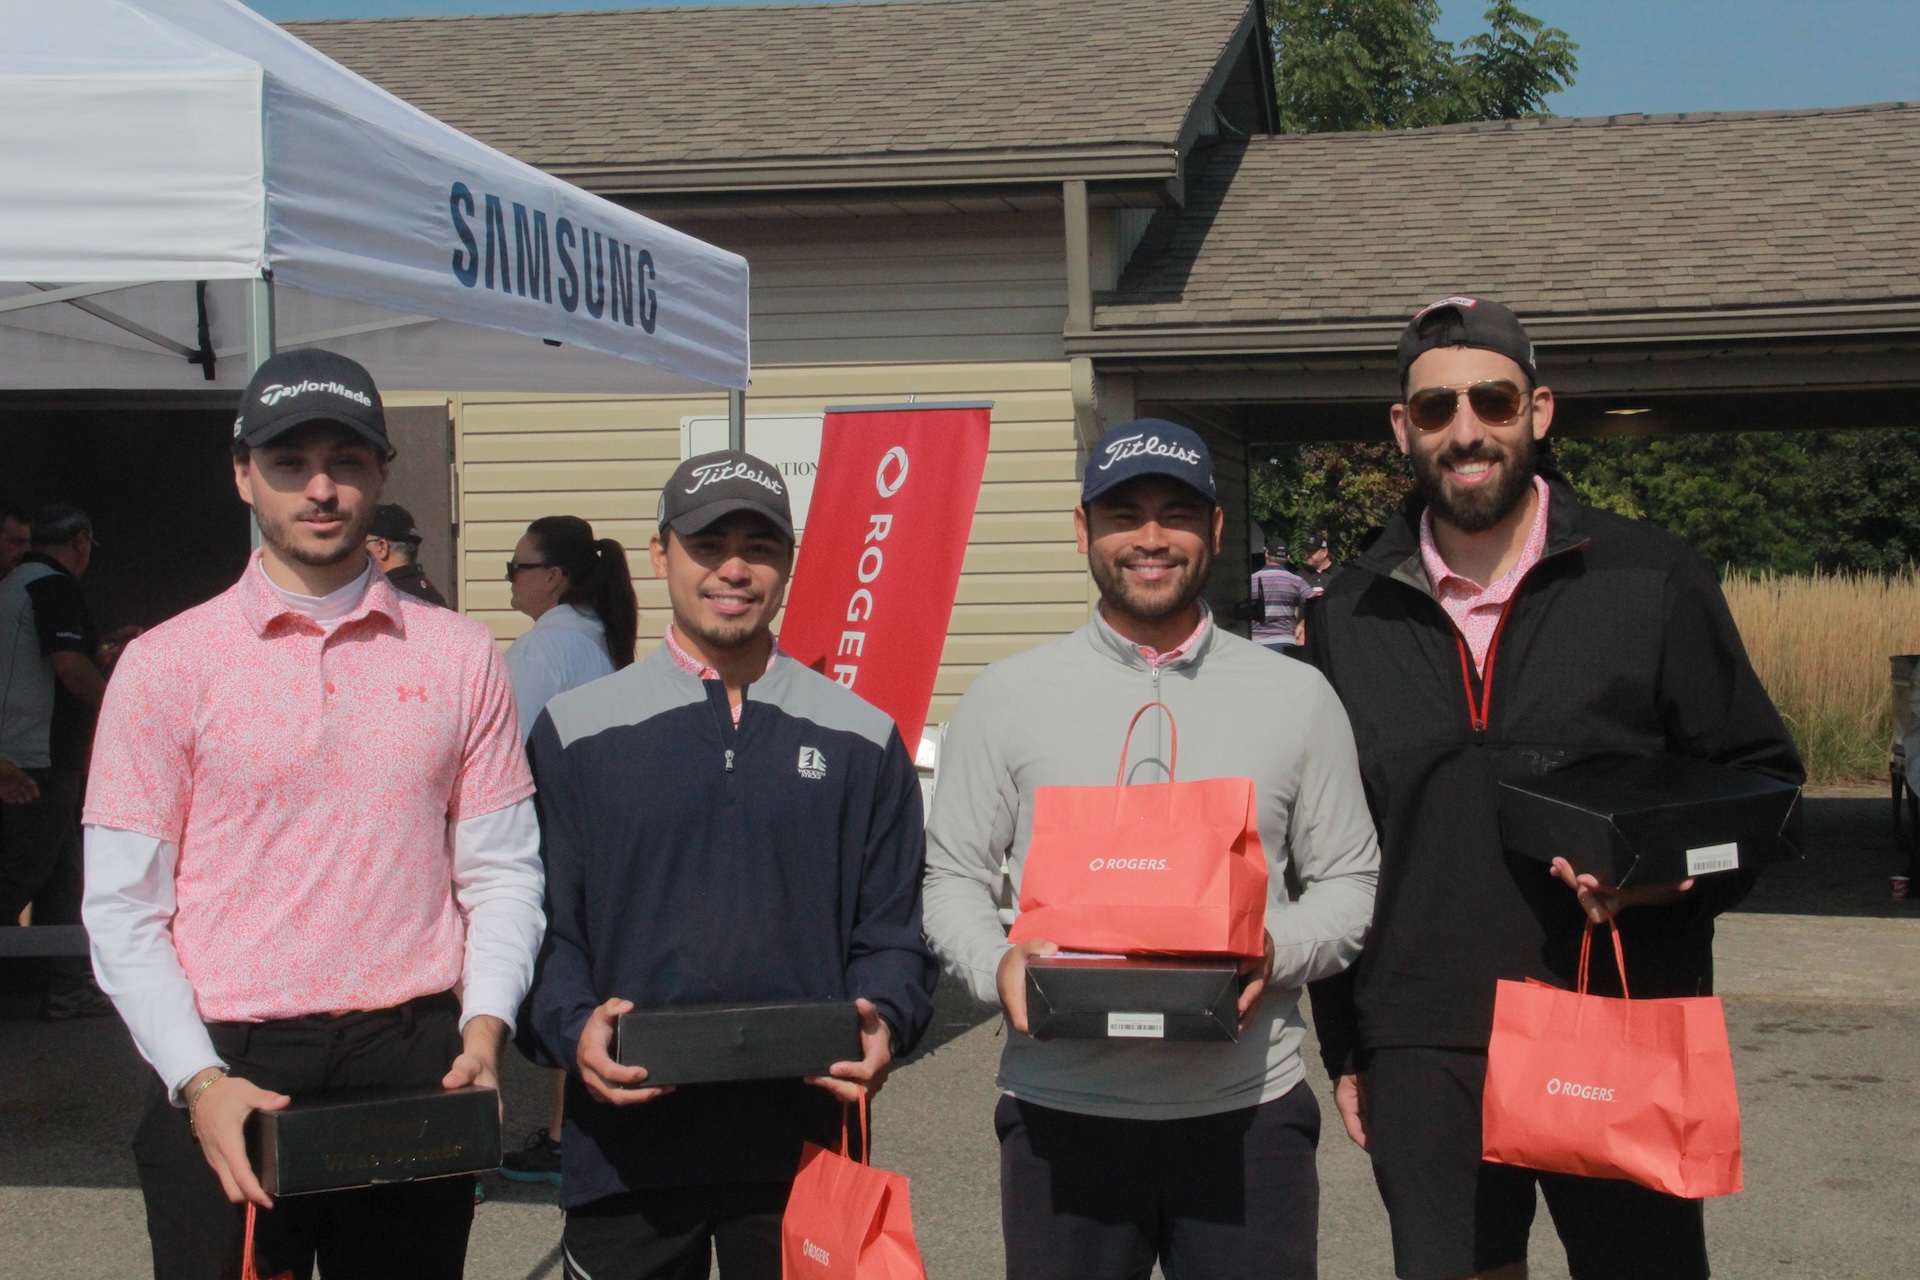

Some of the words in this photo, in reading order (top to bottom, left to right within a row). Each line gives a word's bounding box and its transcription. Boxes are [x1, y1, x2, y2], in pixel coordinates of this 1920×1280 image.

[450, 181, 657, 335] SAMSUNG
[259, 379, 372, 407] TaylorMade
[1098, 433, 1201, 471] Titleist
[684, 459, 784, 495] Titleist
[1106, 858, 1167, 871] ROGERS
[1561, 1081, 1615, 1102] ROGERS
[808, 1242, 830, 1267] ROGERS
